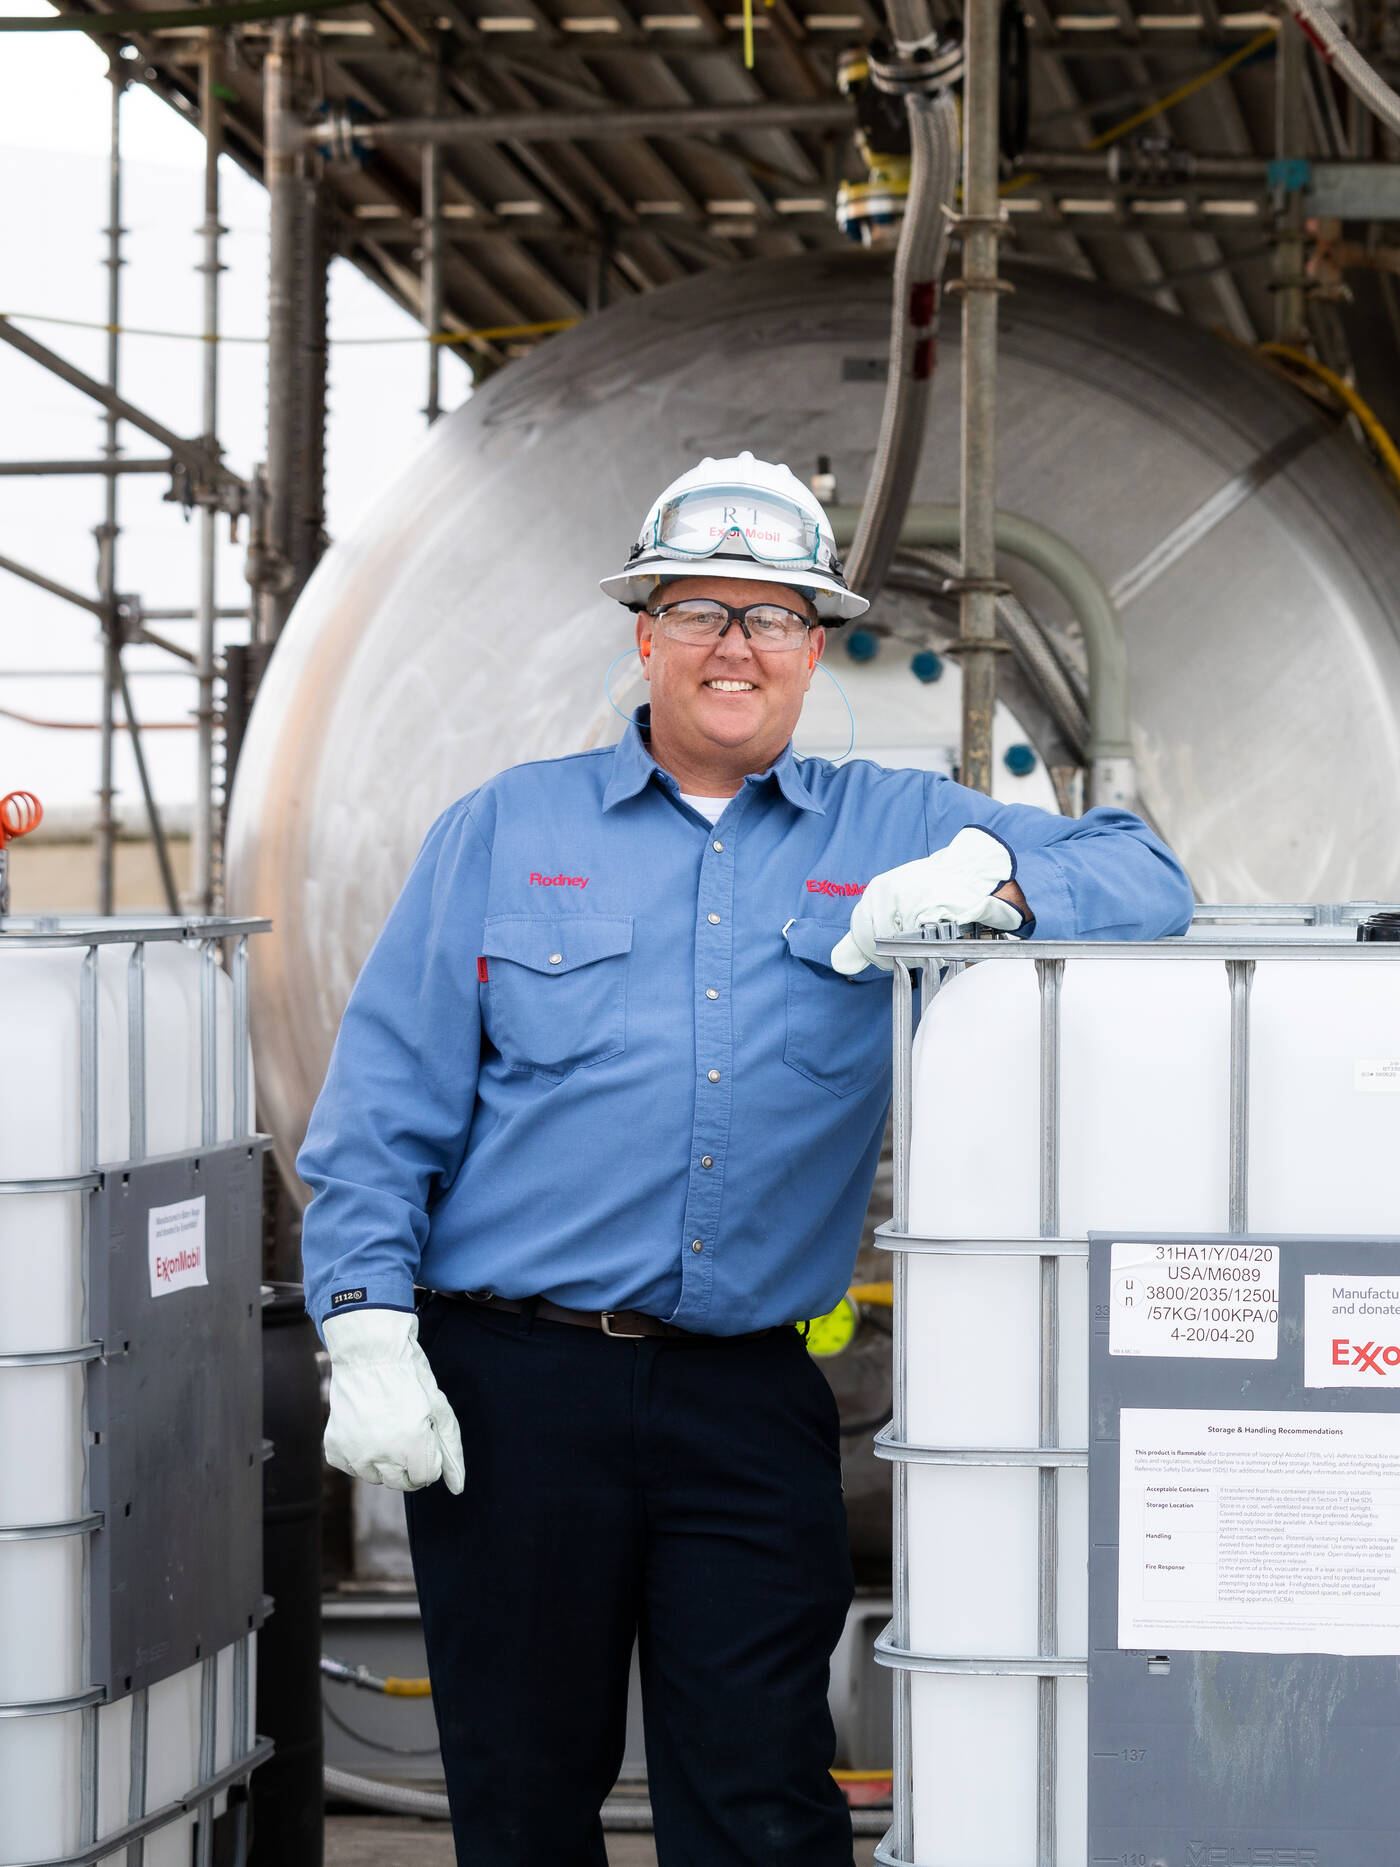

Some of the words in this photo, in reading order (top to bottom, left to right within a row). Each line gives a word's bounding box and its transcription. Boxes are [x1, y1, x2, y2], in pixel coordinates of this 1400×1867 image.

[724, 506, 738, 523] R
[530, 872, 589, 889] Rodney
[1156, 1246, 1273, 1262] 31HA1/Y/04/20
[156, 1246, 200, 1282] ExxonMobil
[1168, 1266, 1260, 1282] USA/M6089
[334, 1292, 353, 1304] 2112
[1146, 1286, 1279, 1302] 3800/2035/1250L
[1148, 1306, 1278, 1323] /57KG/100KPA/0
[1332, 1304, 1355, 1315] and
[1171, 1328, 1254, 1342] 4-20/04-20
[1208, 1426, 1235, 1435] Storage
[1244, 1427, 1277, 1435] Handling
[1278, 1427, 1343, 1435] Recommendations
[1121, 1749, 1147, 1761] 137
